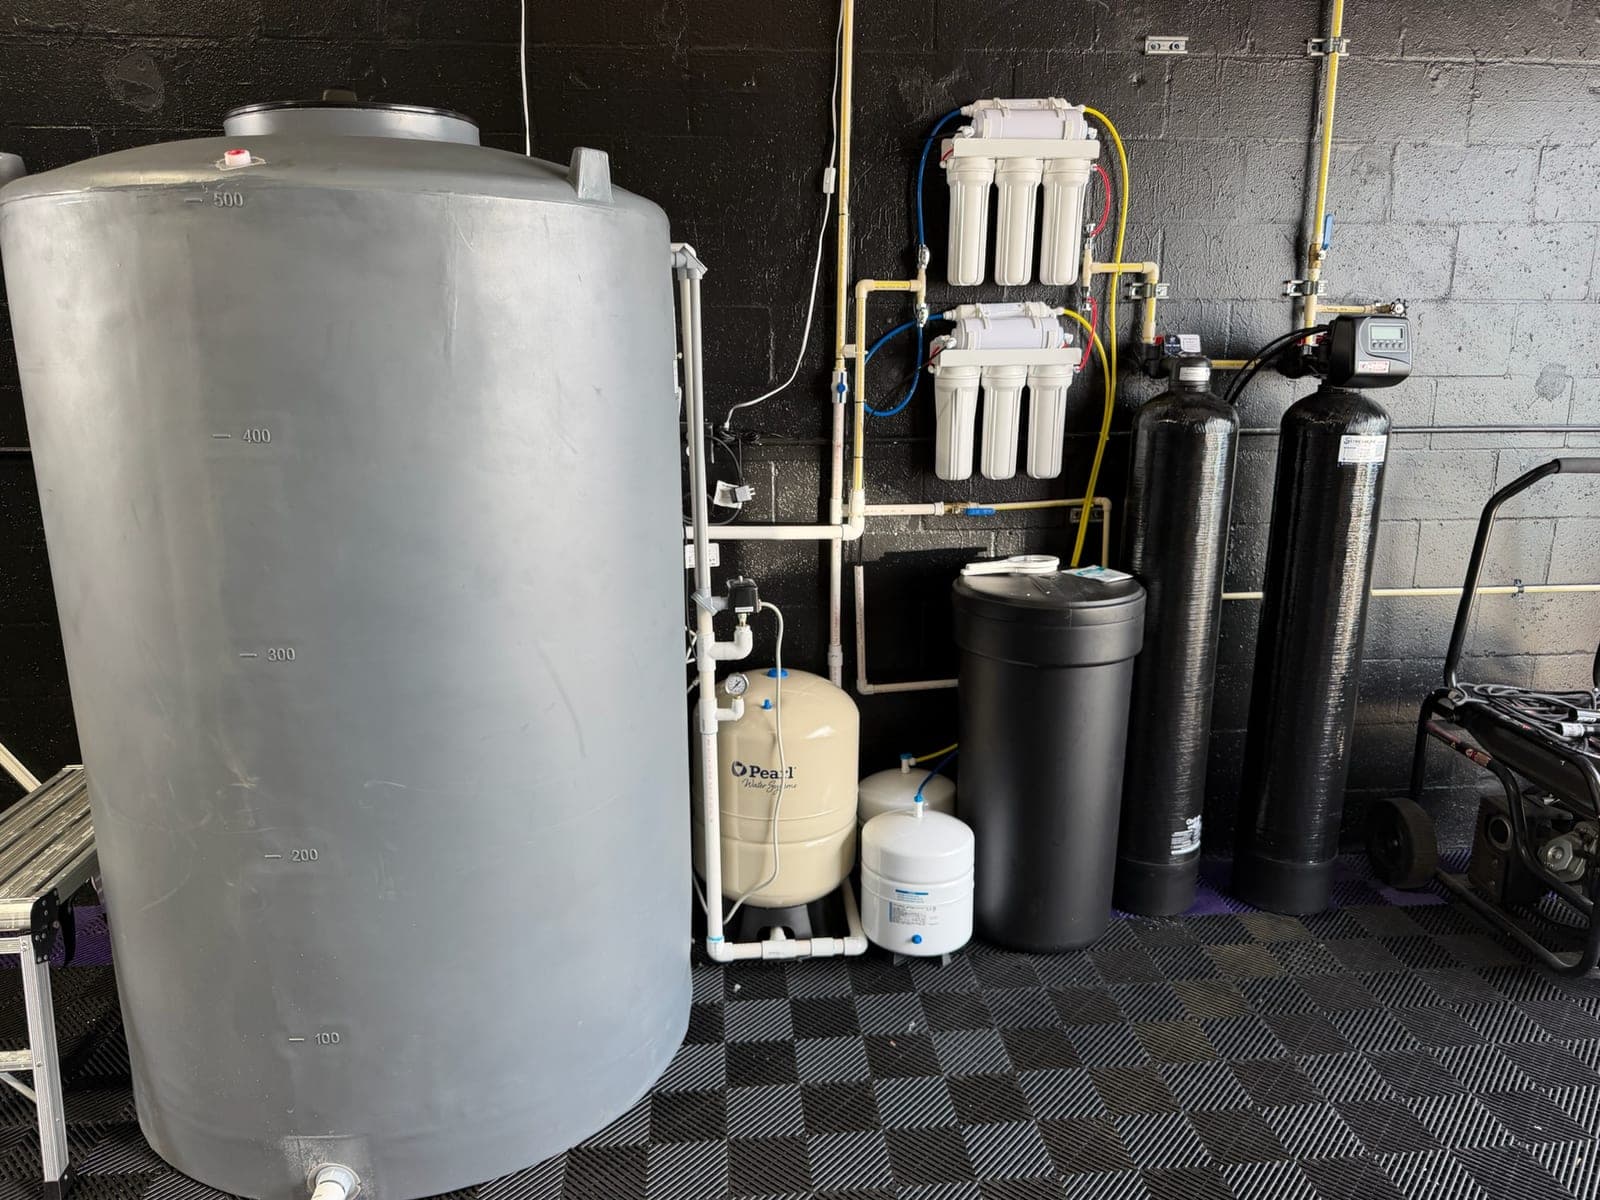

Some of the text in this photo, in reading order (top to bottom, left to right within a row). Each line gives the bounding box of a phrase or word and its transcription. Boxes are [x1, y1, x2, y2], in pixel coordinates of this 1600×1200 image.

[213, 191, 243, 207] 500
[242, 428, 271, 443] 400
[267, 647, 296, 661] 300
[742, 778, 766, 789] Water
[291, 848, 319, 861] 200
[314, 1032, 340, 1044] 100
